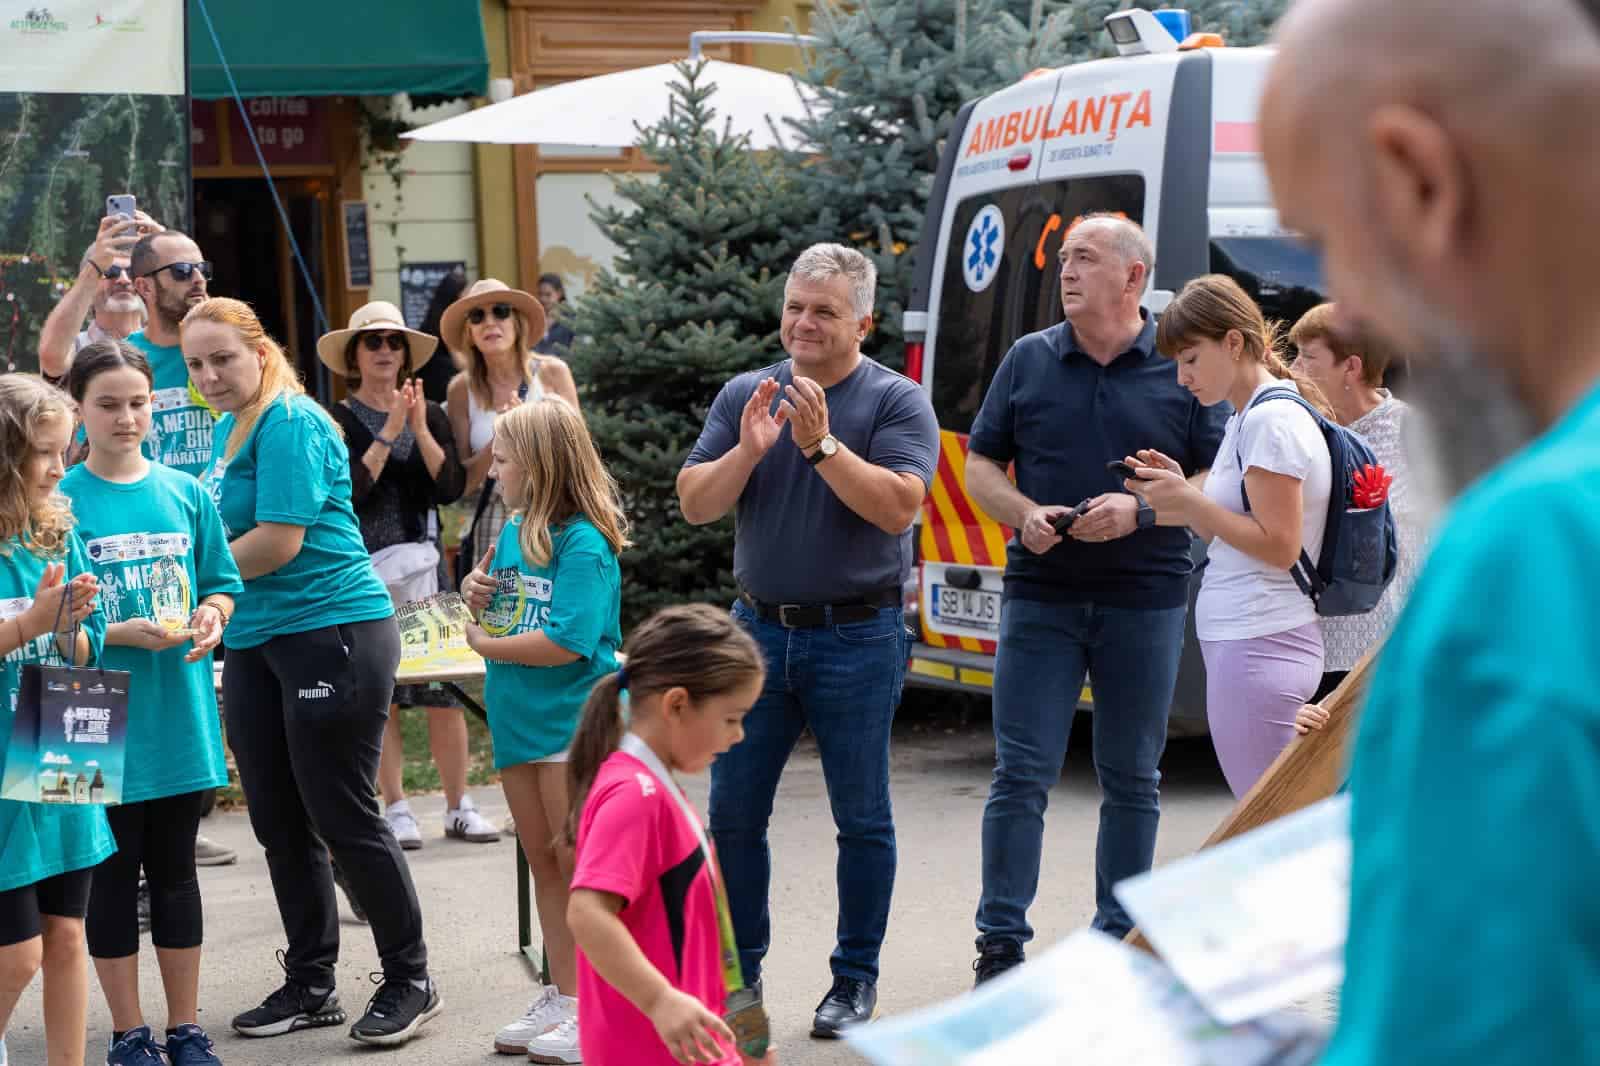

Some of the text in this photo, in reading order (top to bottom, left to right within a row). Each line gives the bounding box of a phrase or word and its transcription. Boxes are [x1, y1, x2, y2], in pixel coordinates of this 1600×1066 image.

[257, 126, 304, 148] to go
[163, 409, 212, 433] MEDIA
[186, 429, 212, 449] BIK
